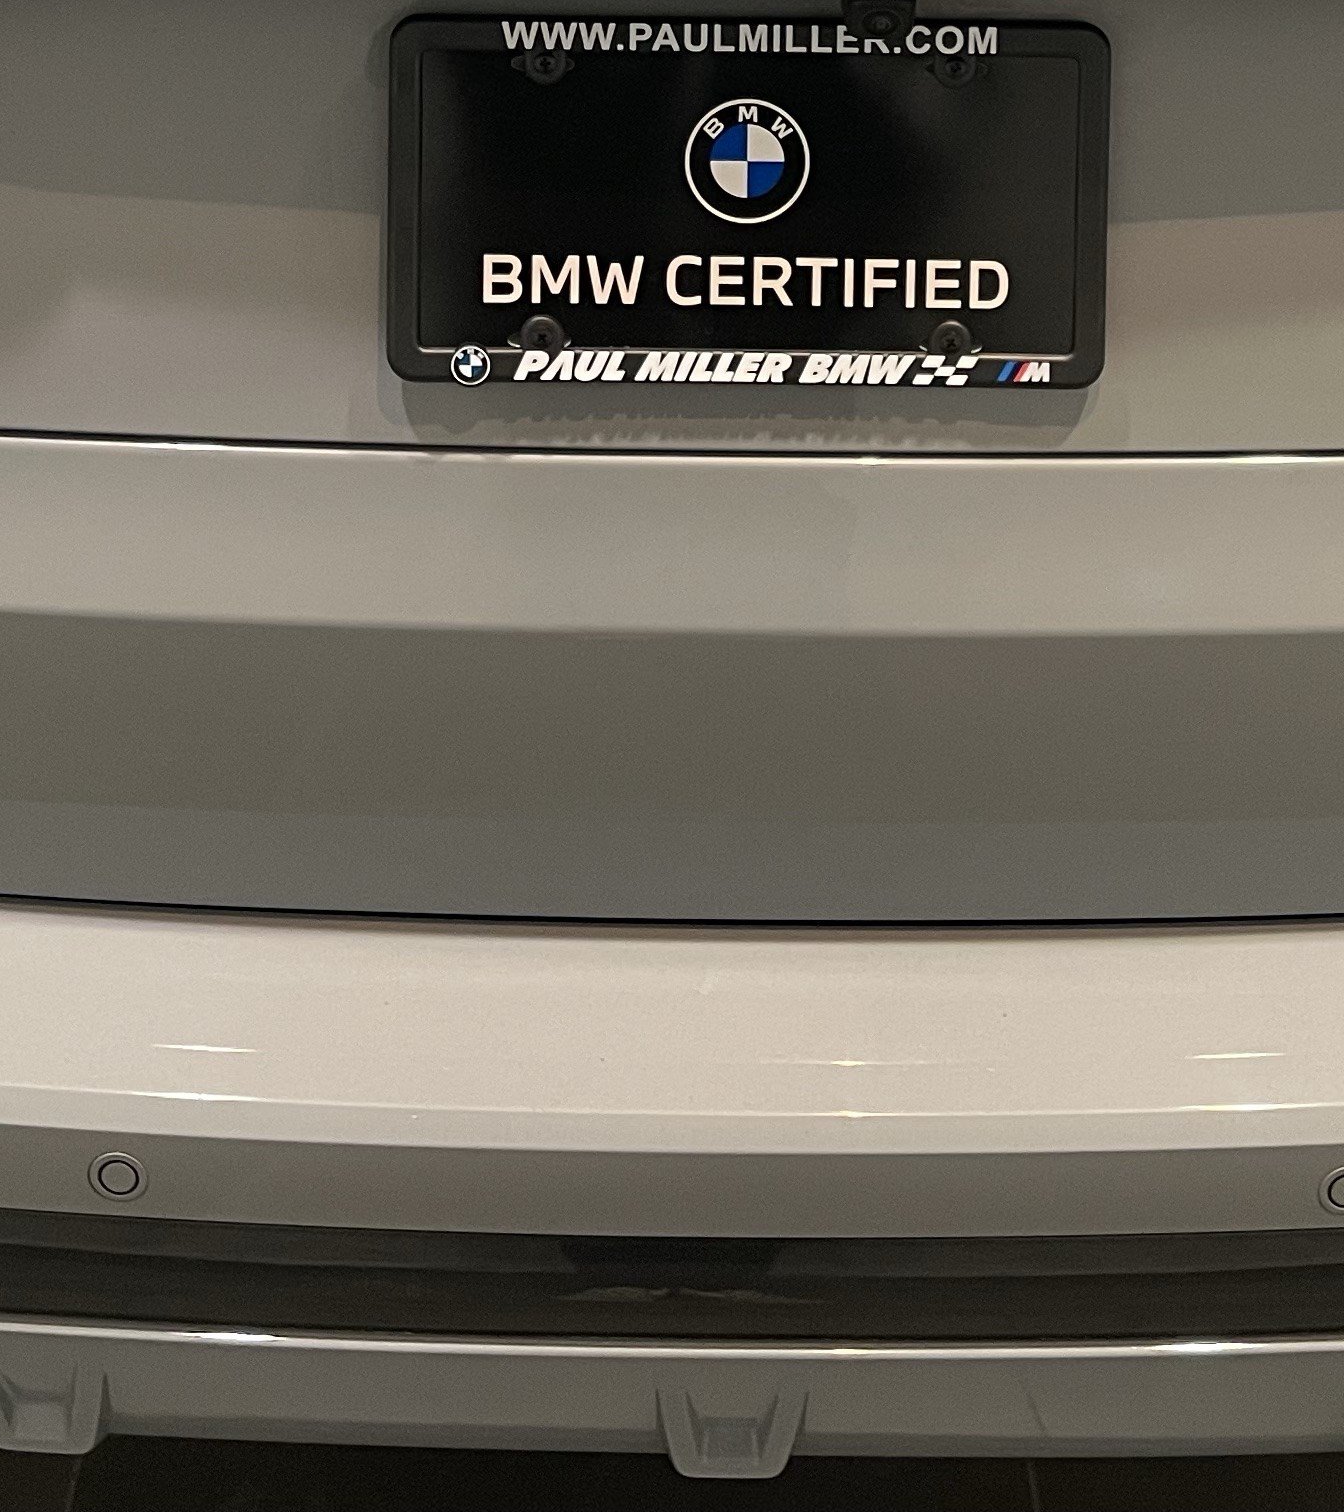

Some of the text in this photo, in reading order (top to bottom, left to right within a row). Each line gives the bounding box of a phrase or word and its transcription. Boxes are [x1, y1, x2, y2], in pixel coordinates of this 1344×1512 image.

[501, 21, 998, 55] WWW.PAULMILLER.COM
[703, 106, 793, 140] BMW
[482, 254, 1010, 310] BMW CERTIFIED
[513, 350, 917, 385] PAUL MILLER BMW
